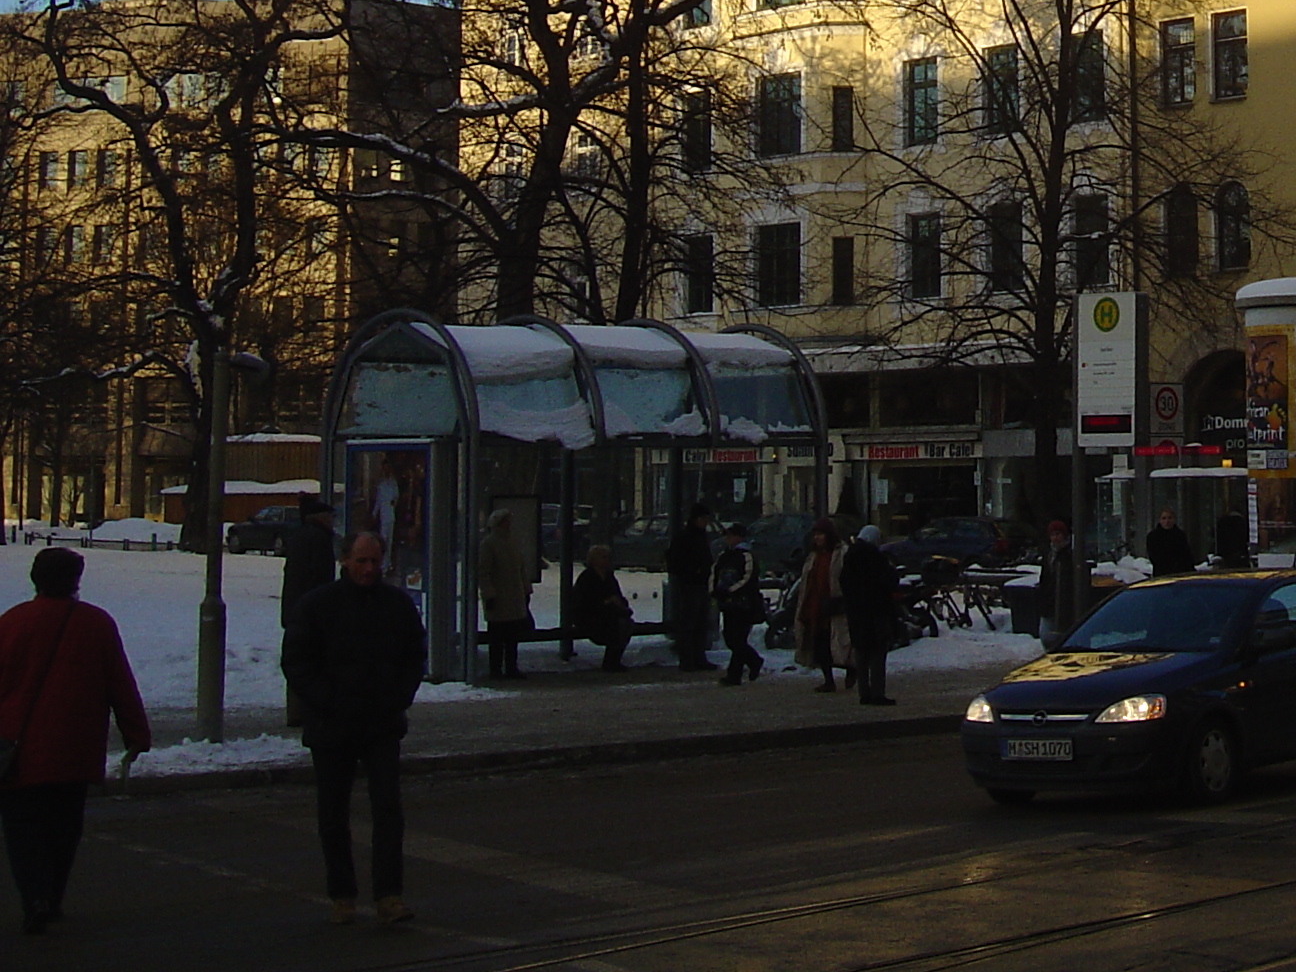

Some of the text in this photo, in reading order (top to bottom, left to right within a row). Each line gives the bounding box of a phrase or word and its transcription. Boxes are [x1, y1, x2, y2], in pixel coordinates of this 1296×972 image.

[1160, 396, 1175, 411] 30
[868, 444, 920, 459] Restaurant
[929, 443, 947, 458] Bar
